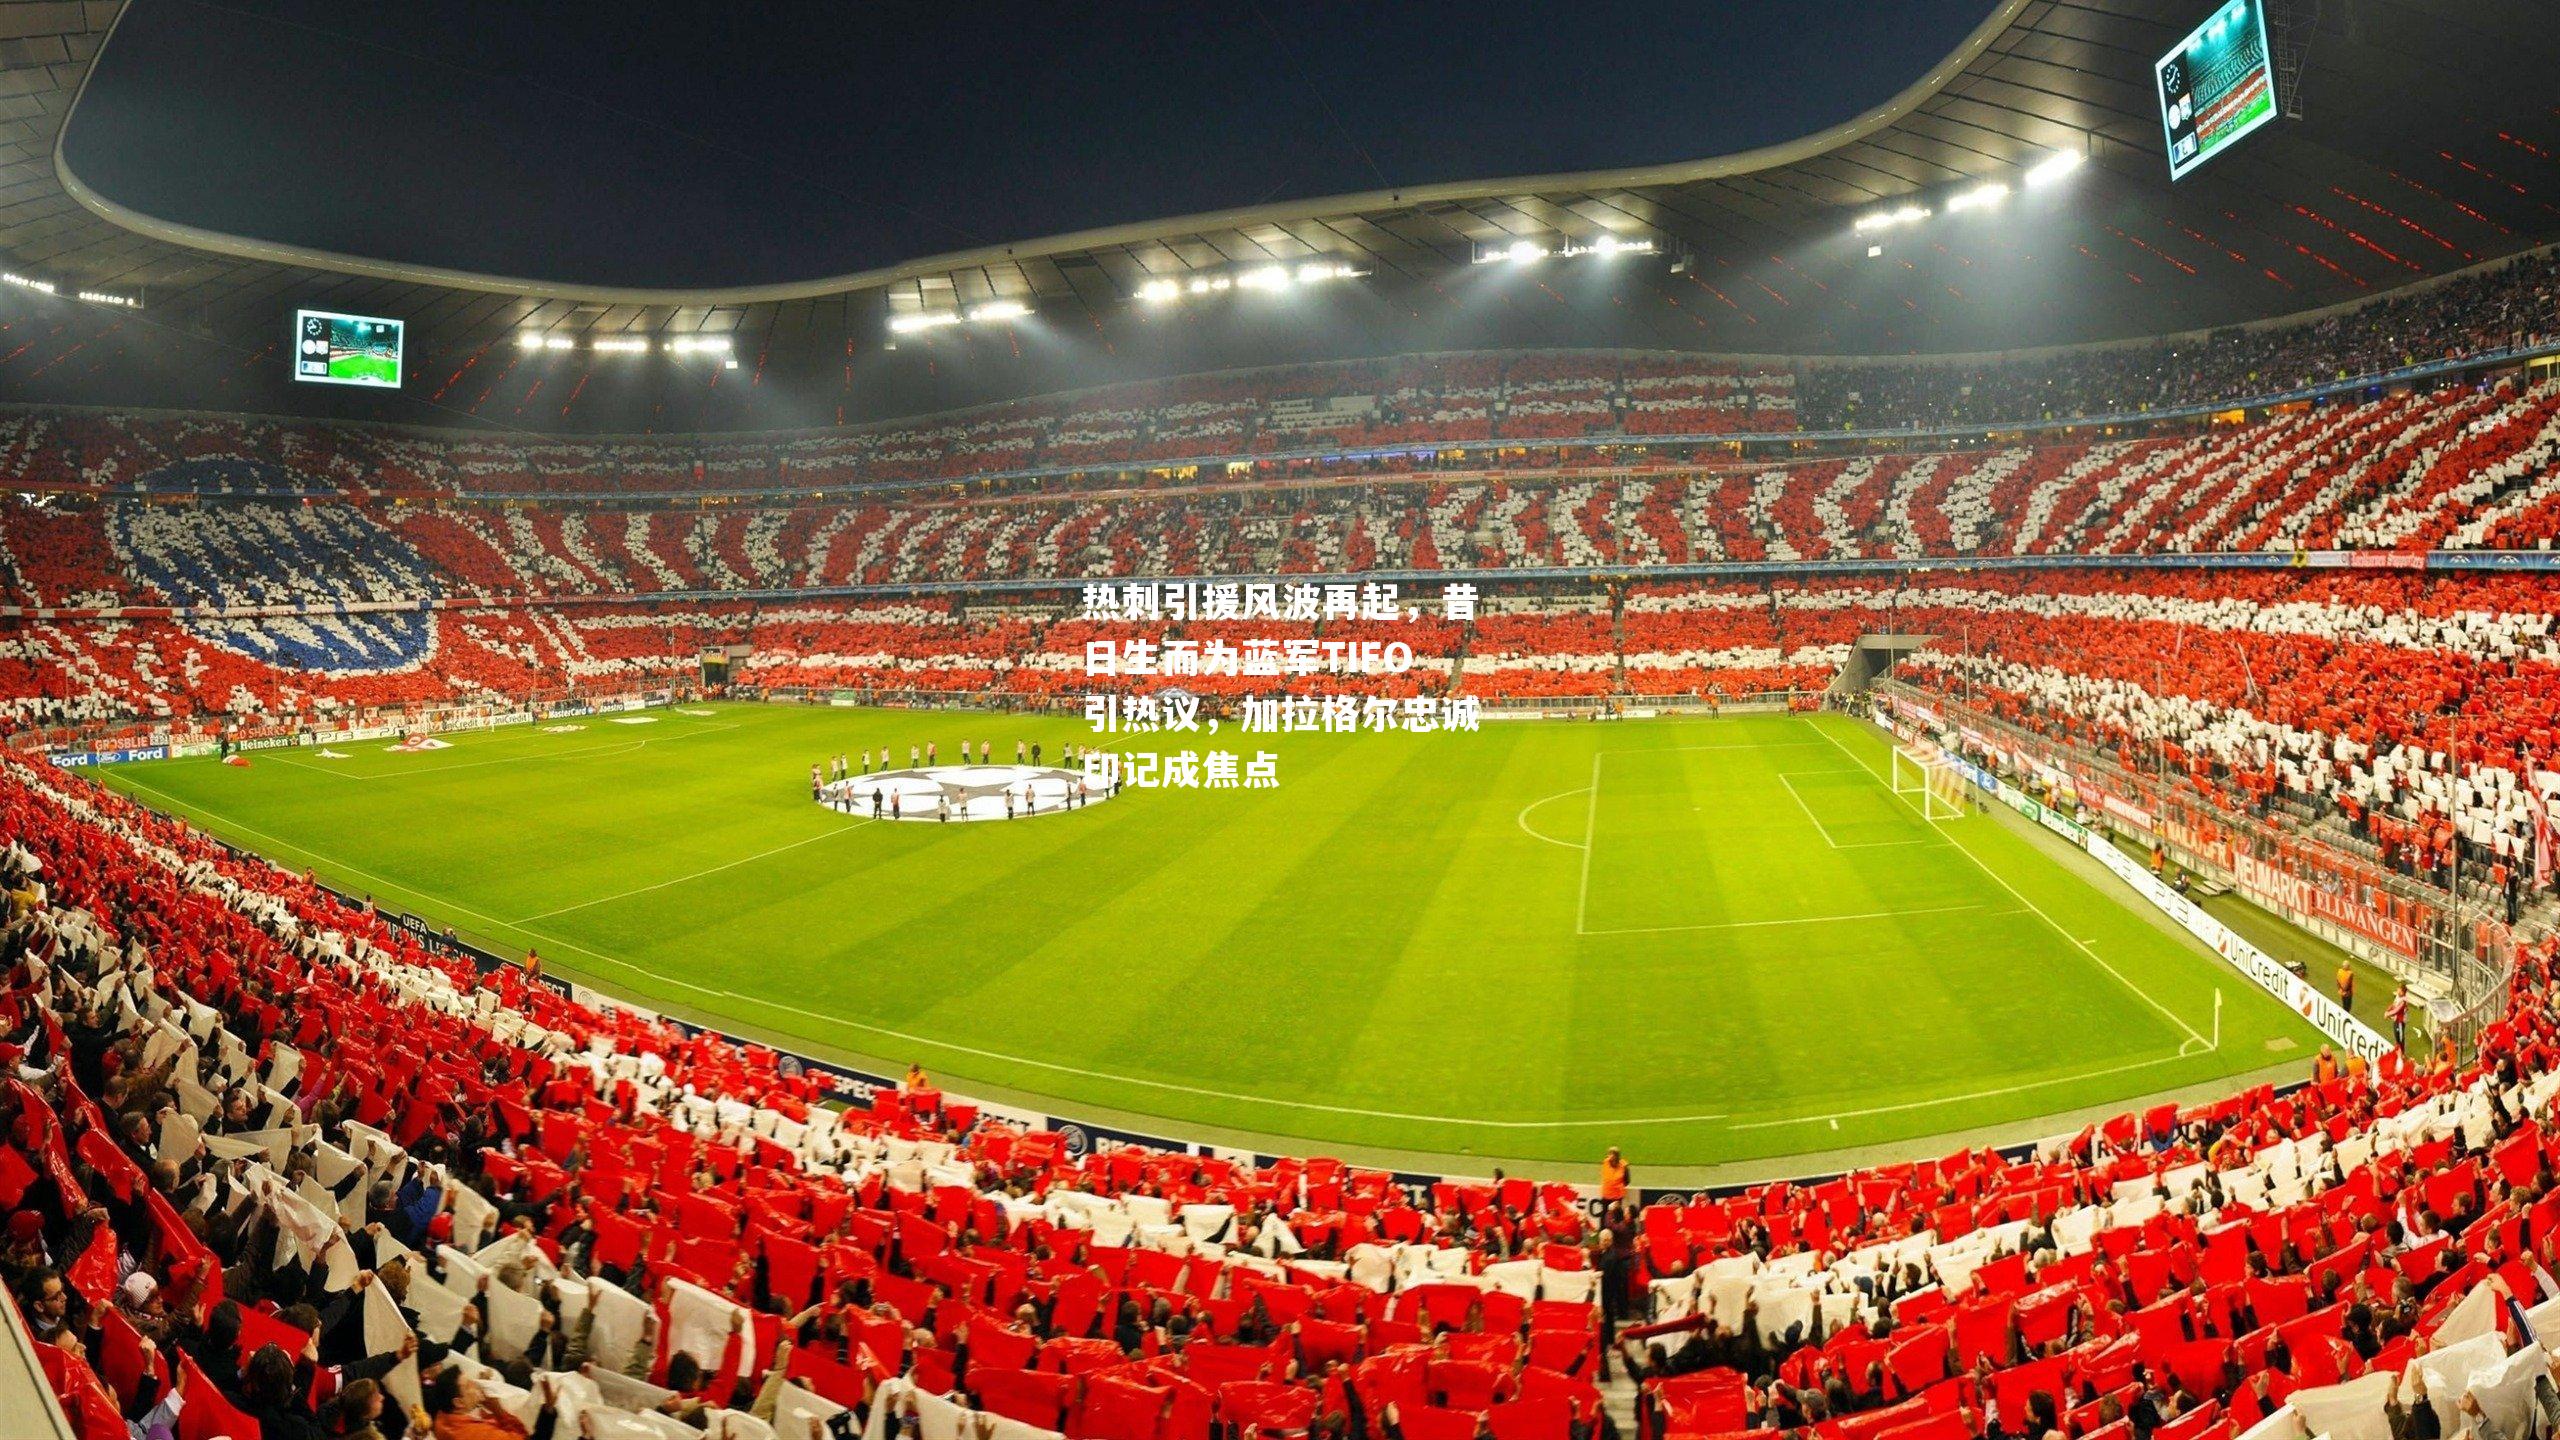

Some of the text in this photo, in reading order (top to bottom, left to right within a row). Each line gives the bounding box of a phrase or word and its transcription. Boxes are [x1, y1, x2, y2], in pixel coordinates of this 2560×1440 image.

[128, 748, 163, 761] Ford
[240, 737, 288, 751] Heineken
[52, 754, 88, 767] Ford
[2155, 881, 2189, 924] PS3
[402, 914, 428, 934] UEFA
[2316, 890, 2416, 953] ELLWANGEN
[2229, 936, 2289, 1000] UniCredit
[2316, 997, 2391, 1062] UniCredi
